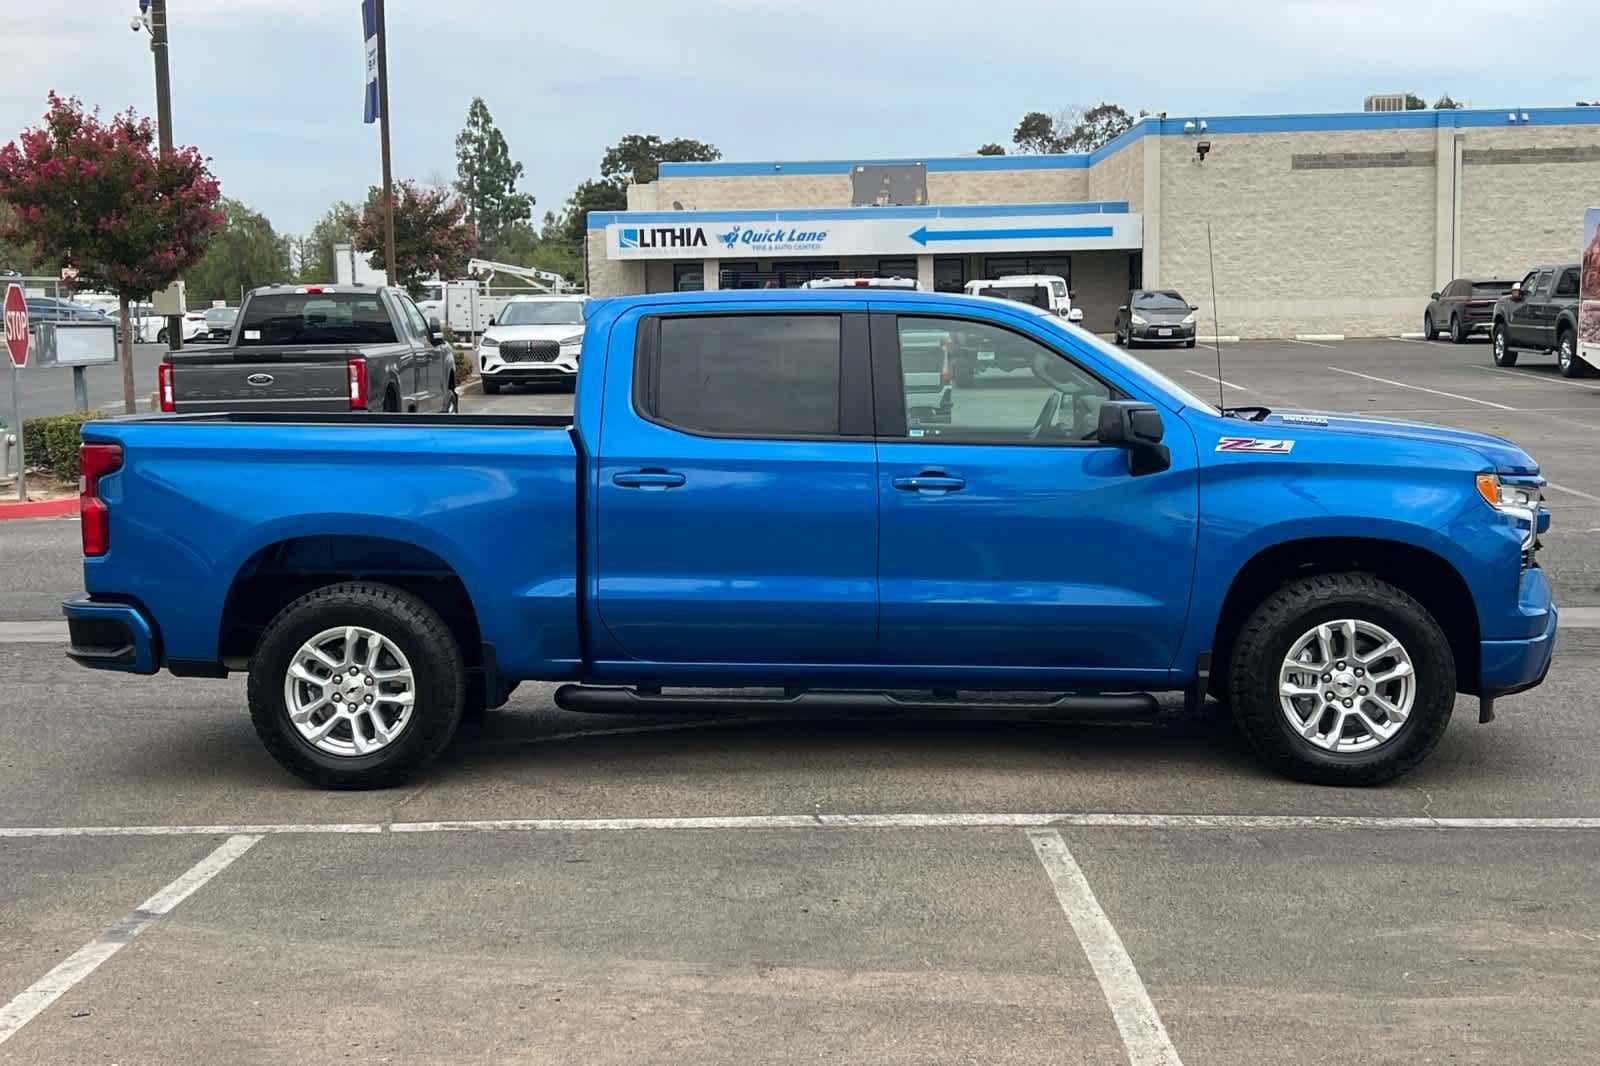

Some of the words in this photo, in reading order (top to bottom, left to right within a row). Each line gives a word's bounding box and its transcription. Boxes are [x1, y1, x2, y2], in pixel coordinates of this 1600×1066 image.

[640, 228, 707, 247] LITHIA
[741, 229, 784, 244] Quick
[787, 229, 827, 241] Lane
[7, 311, 27, 341] STOP
